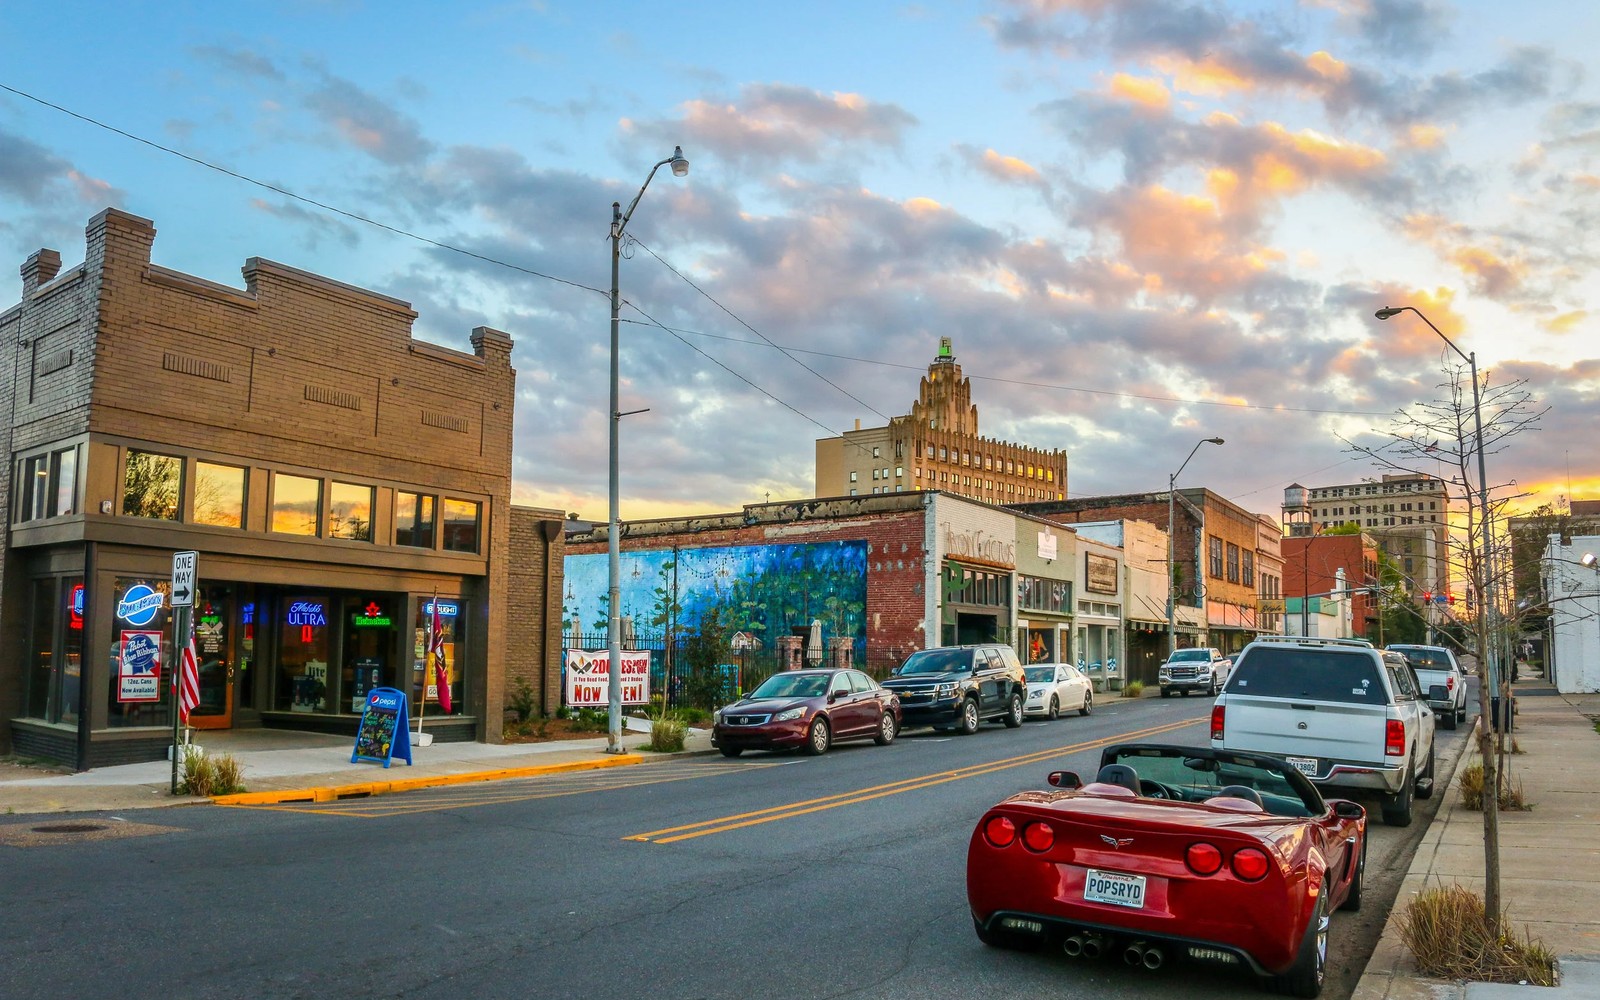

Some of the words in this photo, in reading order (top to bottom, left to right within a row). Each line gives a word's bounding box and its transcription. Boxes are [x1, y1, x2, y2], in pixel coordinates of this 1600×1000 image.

[175, 556, 192, 569] ONE
[175, 571, 191, 584] WAY
[288, 612, 326, 625] ULTRA
[592, 659, 632, 674] 2DUES
[379, 698, 396, 706] pepsi
[1089, 878, 1141, 898] POPSRYD
